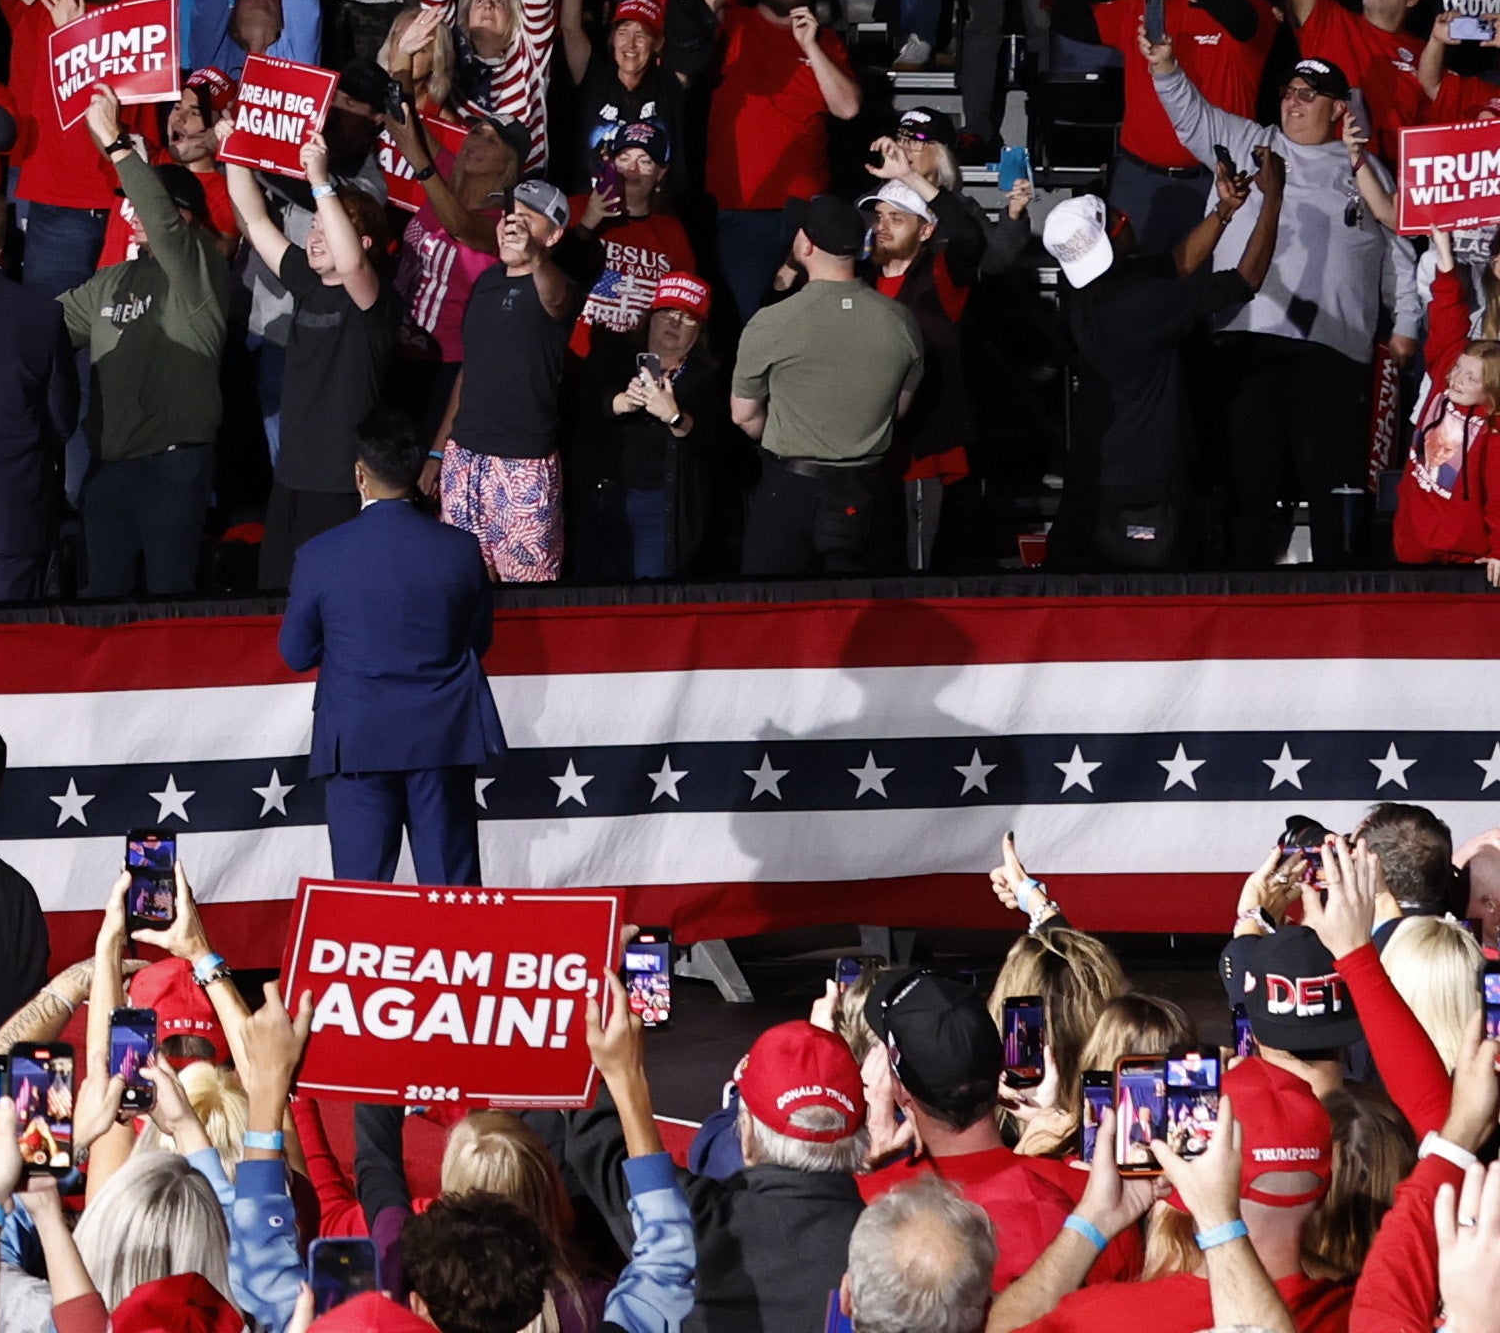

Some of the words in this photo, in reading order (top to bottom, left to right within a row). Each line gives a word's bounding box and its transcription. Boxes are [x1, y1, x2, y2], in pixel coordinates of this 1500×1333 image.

[54, 24, 167, 81] TRUMP
[57, 67, 97, 102] WILL
[99, 56, 137, 78] FIX
[143, 52, 166, 73] IT
[239, 83, 282, 109] DREAM
[284, 89, 318, 120] BIG,
[235, 105, 306, 145] AGAIN!
[1409, 149, 1500, 187] TRUM
[1409, 184, 1465, 206] WILL
[599, 237, 671, 273] ESUS
[679, 290, 702, 305] AGAIN
[308, 939, 491, 988] DREAM
[504, 952, 599, 999] BIG,
[163, 1019, 214, 1031] TRUMP
[309, 982, 576, 1050] AGAIN!
[404, 1083, 461, 1103] 2024
[776, 1085, 823, 1110] DONALD
[824, 1087, 856, 1113] TRUMP
